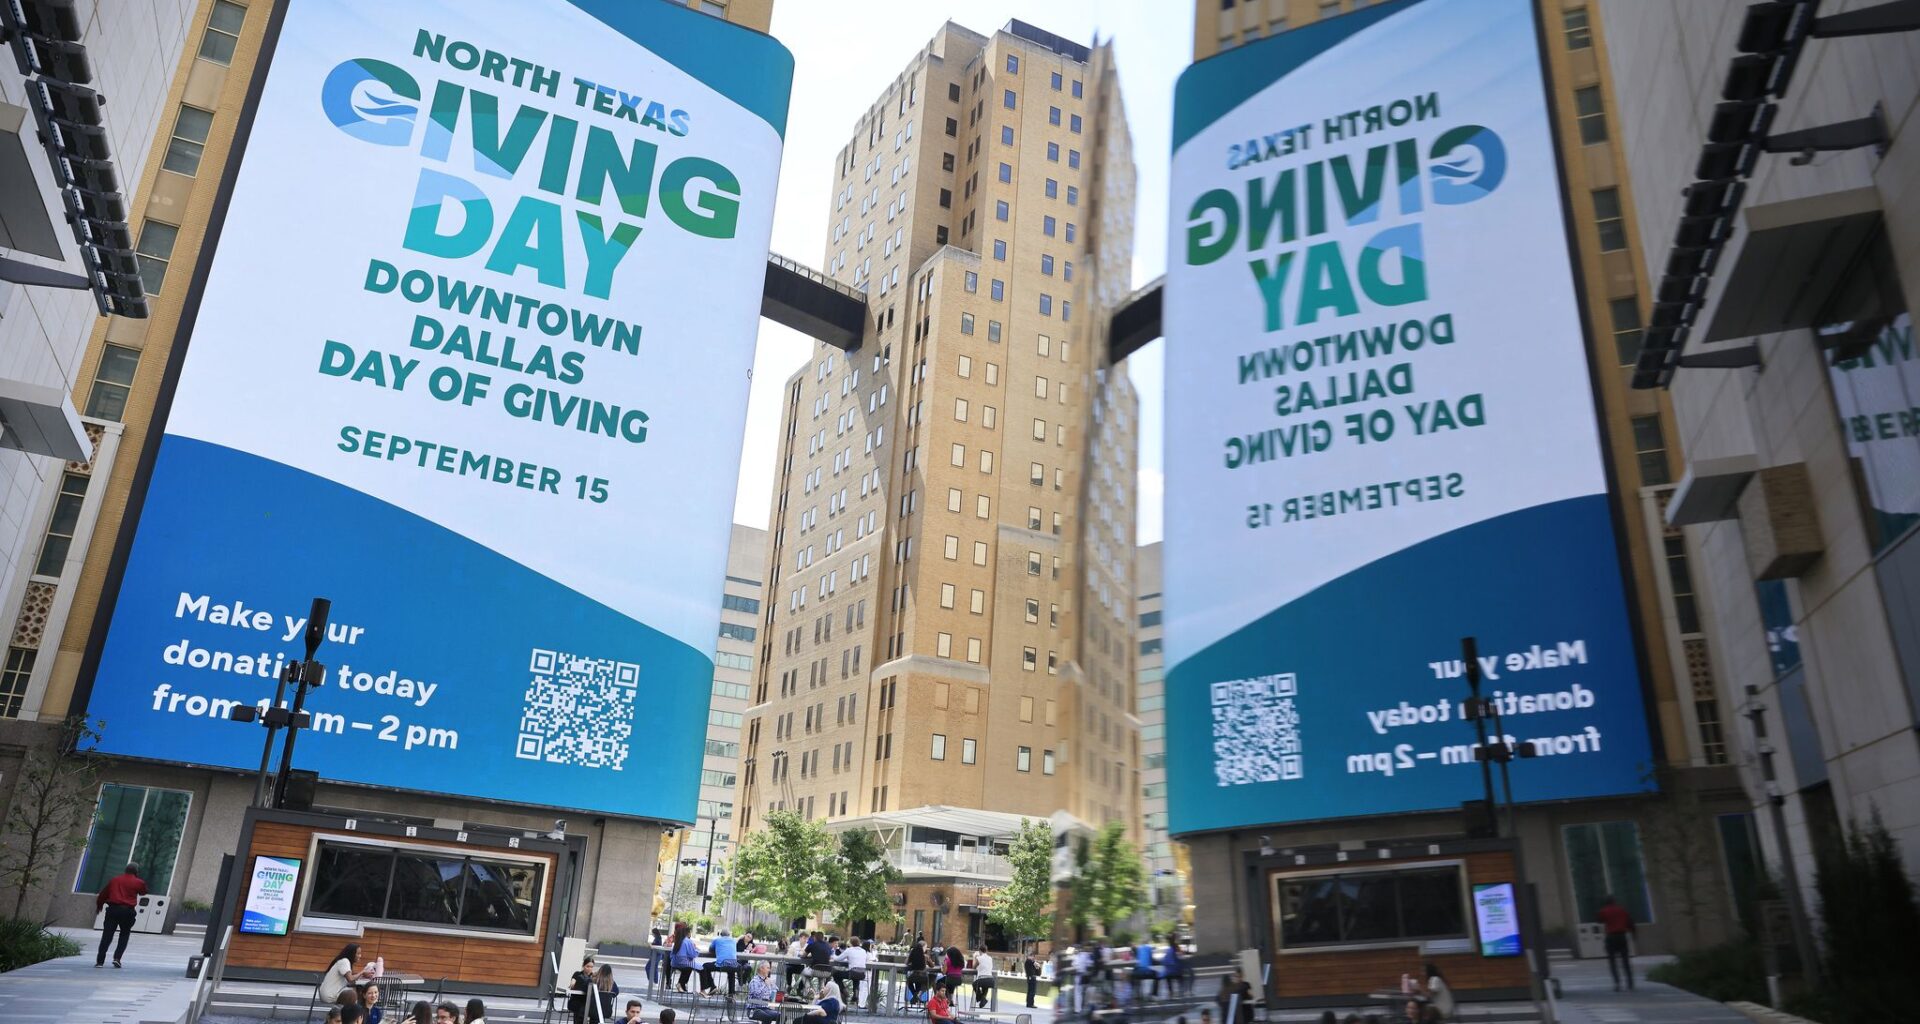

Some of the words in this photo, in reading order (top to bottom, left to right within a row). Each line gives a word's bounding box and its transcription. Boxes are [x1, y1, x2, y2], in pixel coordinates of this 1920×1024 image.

[413, 29, 561, 98] NORTH
[572, 77, 691, 137] TEXAS
[321, 58, 741, 239] GIVING
[402, 167, 643, 301] DAY
[364, 258, 642, 356] DOWNTOWN
[409, 315, 585, 384] DALLAS
[318, 339, 420, 391] DAY
[428, 366, 492, 406] OF
[503, 383, 649, 443] GIVING
[337, 425, 562, 496] SEPTEMBER
[575, 474, 609, 503] 15
[175, 592, 273, 631] Make
[282, 615, 365, 645] yur
[162, 640, 327, 686] donati
[338, 664, 437, 707] today
